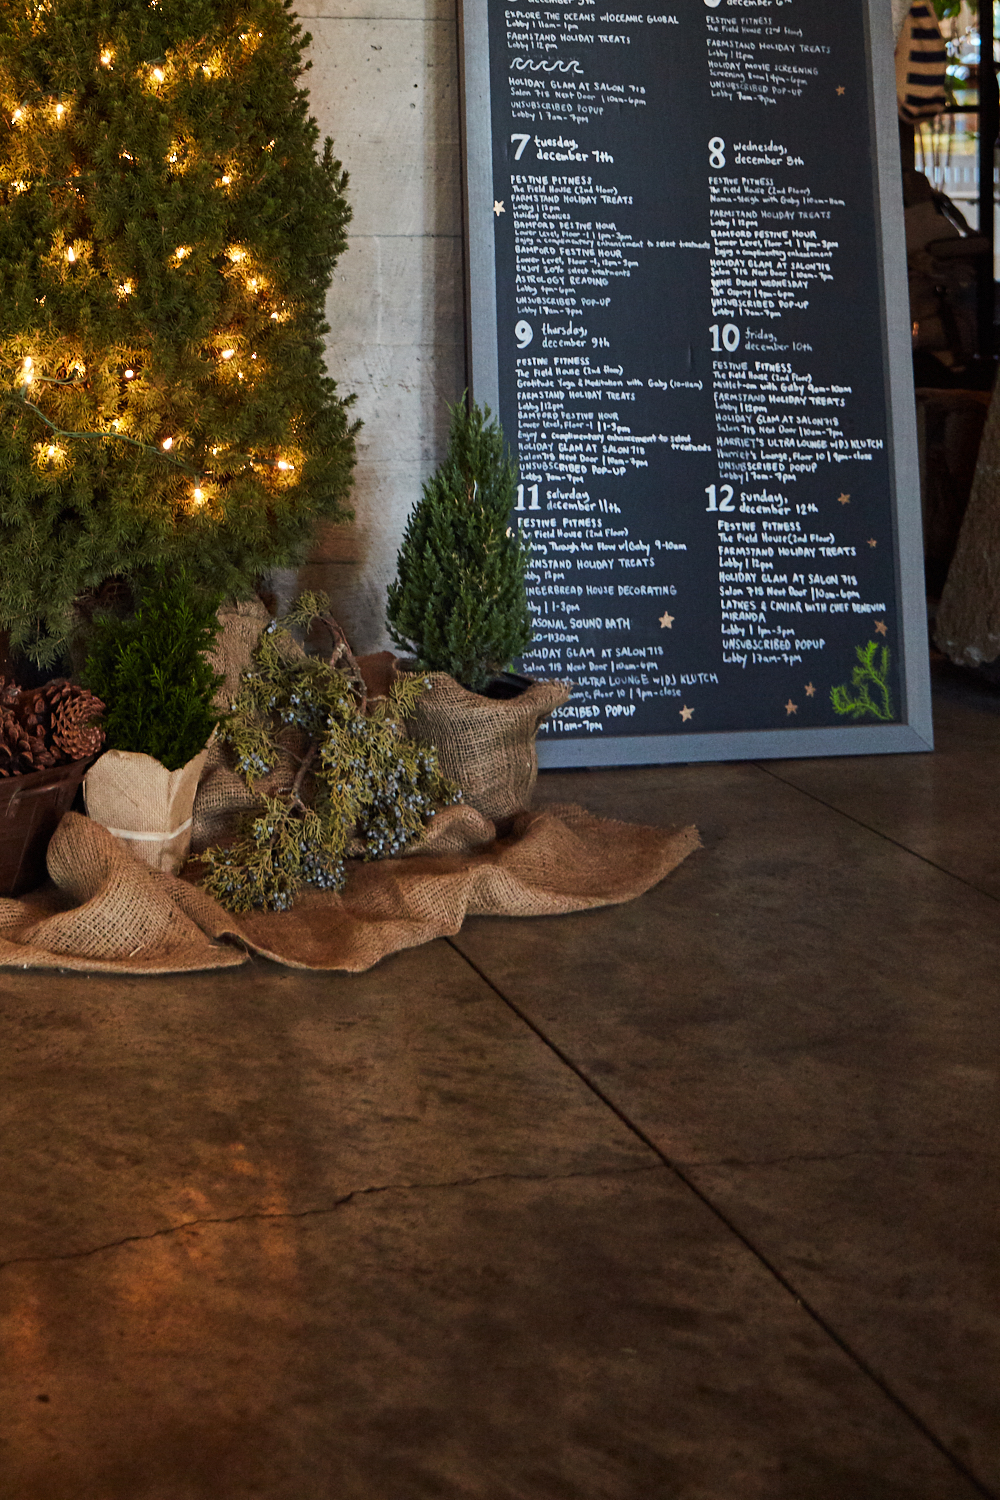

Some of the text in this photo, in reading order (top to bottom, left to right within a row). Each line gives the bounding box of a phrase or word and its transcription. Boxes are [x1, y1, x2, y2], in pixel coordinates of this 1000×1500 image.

[504, 10, 541, 20] EXPLORE
[544, 11, 561, 20] THE
[563, 12, 595, 22] OCEANS
[646, 14, 679, 24] GLOBAL
[706, 38, 831, 55] FARMSTAND HOLIDAY TREATS
[707, 60, 741, 70] HOLIDAY
[744, 63, 771, 72] MOVIE
[508, 76, 545, 89] HOLIDAY
[550, 79, 576, 90] GLAM
[578, 81, 590, 91] AT
[593, 82, 625, 93] SALON
[510, 133, 531, 161] 7
[534, 135, 579, 149] tuesday,
[733, 140, 788, 155] wednesday,
[536, 149, 614, 163] december 7th
[708, 136, 726, 169] 8
[734, 154, 805, 167] december 8th
[510, 194, 633, 205] FARMSTAND HOLIDAY TREATS
[710, 230, 752, 238] BAMFORD
[792, 230, 817, 239] HOUR
[515, 274, 609, 287] ASTROLOGY READING
[710, 278, 809, 289] WINE DOWN WEDNESDAY
[515, 297, 576, 306] UNSUBSCRIBED
[514, 319, 534, 349] 9
[709, 323, 741, 353] 10
[745, 327, 778, 342] friday,
[542, 337, 610, 348] december 9th
[745, 342, 813, 352] december 10th
[555, 368, 580, 377] House
[516, 390, 636, 401] FARMSTAND HOLIDAY TREATS
[714, 391, 845, 407] FARMSTAND HOLIDAY TREATS
[519, 462, 587, 474] UNSUBSCRIBED
[718, 462, 785, 472] UNSUBSCRIBED
[513, 483, 542, 511] 11
[705, 484, 736, 513] 12
[546, 499, 622, 514] december 11th
[739, 502, 819, 515] december 12th
[717, 546, 856, 558] FARMSTAND HOLIDAY TREATS
[586, 585, 615, 595] HOUSE
[617, 585, 677, 596] DECORATING
[770, 601, 803, 613] CAVIAR
[804, 602, 827, 613] WITH
[570, 618, 603, 630] SOUND
[605, 617, 631, 630] BATH
[721, 612, 766, 623] MIRANDA
[722, 638, 791, 650] UNSUBSCRIBED
